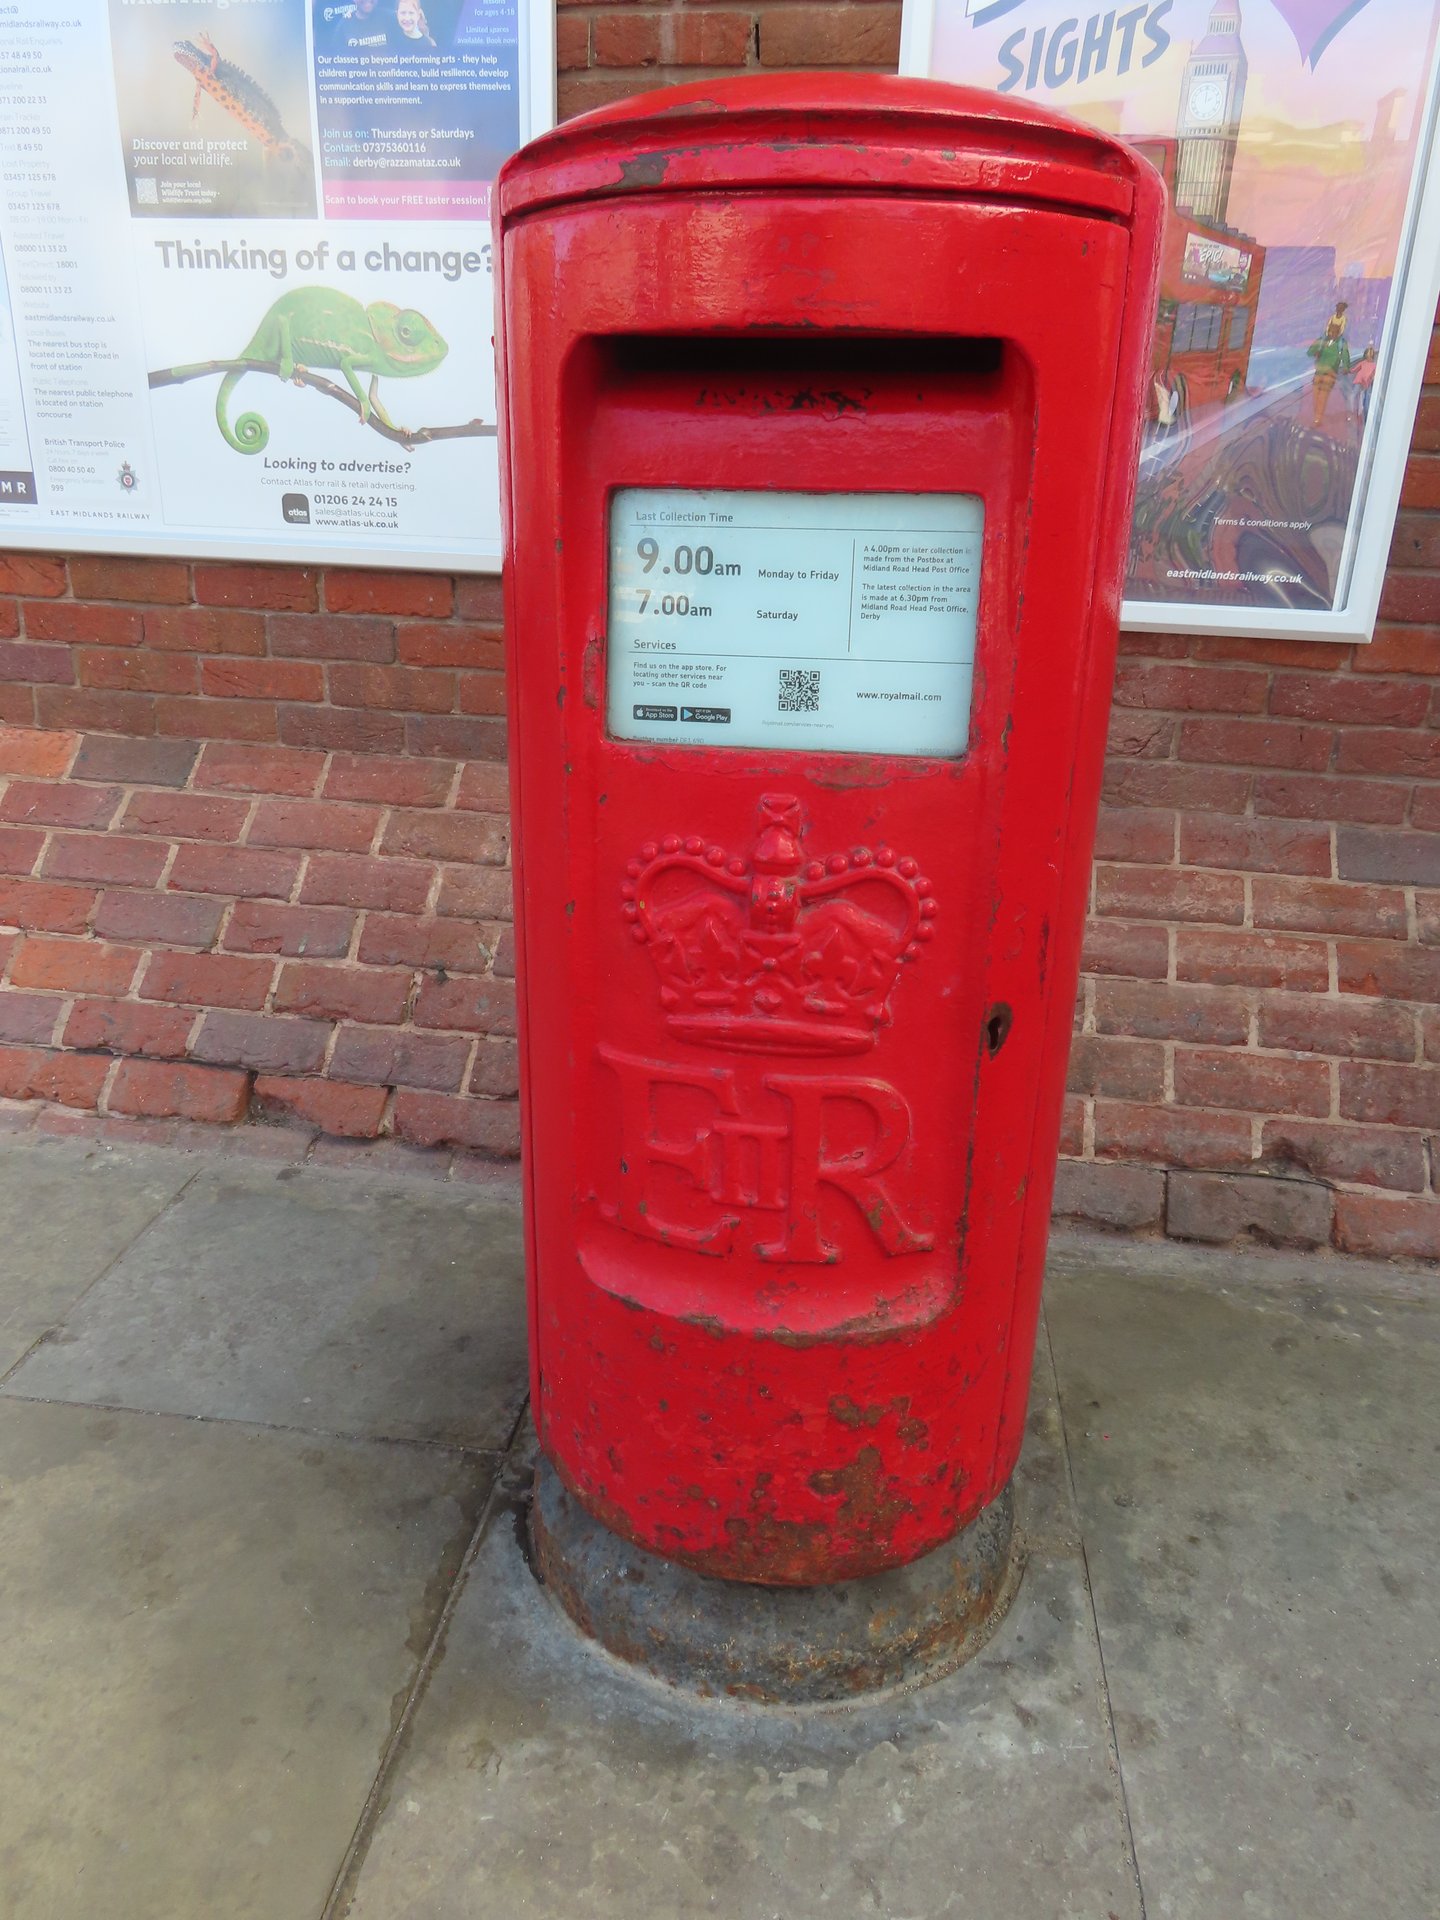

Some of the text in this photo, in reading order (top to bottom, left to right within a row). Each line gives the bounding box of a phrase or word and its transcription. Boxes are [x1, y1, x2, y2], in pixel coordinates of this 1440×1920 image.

[997, 0, 1174, 92] SIGHTS
[318, 56, 497, 66] Our classes beyond performing arts they help
[319, 69, 508, 79] children grow confidence, build resilience, develop
[320, 82, 374, 91] communication
[376, 82, 393, 90] skills
[395, 82, 408, 90] and
[410, 82, 428, 90] learn
[469, 82, 511, 90] themselves
[334, 96, 373, 105] supportive
[323, 129, 341, 138] Join
[371, 128, 417, 139] Thursdays
[431, 128, 474, 139] Saturdays
[133, 139, 248, 152] Discover and protect
[323, 143, 426, 152] Contact: 07375360116
[134, 153, 232, 167] your local wildlife.
[325, 157, 461, 168] Email: derby@razzamataz.co.uk
[325, 195, 486, 206] Scan book your FREE taster session!
[155, 240, 287, 279] Thinking
[295, 241, 329, 270] of
[336, 251, 355, 270] a
[1200, 249, 1224, 264] EPIC!
[30, 362, 48, 370] front
[76, 390, 96, 398] public
[45, 438, 125, 448] British Transport Police
[264, 457, 411, 473] Looking to advertise?
[261, 477, 416, 491] Contact Atlas for rail retail advertising.
[314, 495, 397, 507] 01206 24 24 15
[288, 508, 307, 516] atlas
[315, 509, 398, 518] sales@atlas-uk.co.uk
[636, 512, 733, 522] Last Collection Time
[315, 519, 398, 528] www.atlas-uk.co.uk
[1214, 518, 1312, 530] Terms conditions apply
[871, 545, 900, 554] 4.00pm
[637, 537, 741, 576] 9.00am
[949, 566, 970, 574] Office
[758, 570, 839, 581] Monday to Friday
[1166, 569, 1302, 584] eastmidlandsrailway.co.uk
[636, 589, 712, 616] 7.00am
[900, 594, 928, 603] 6.30pm
[757, 610, 798, 620] Saturday
[634, 639, 676, 649] Services
[633, 671, 658, 679] locating
[857, 691, 942, 702] www.royalmail.com
[695, 713, 727, 721] Google Play
